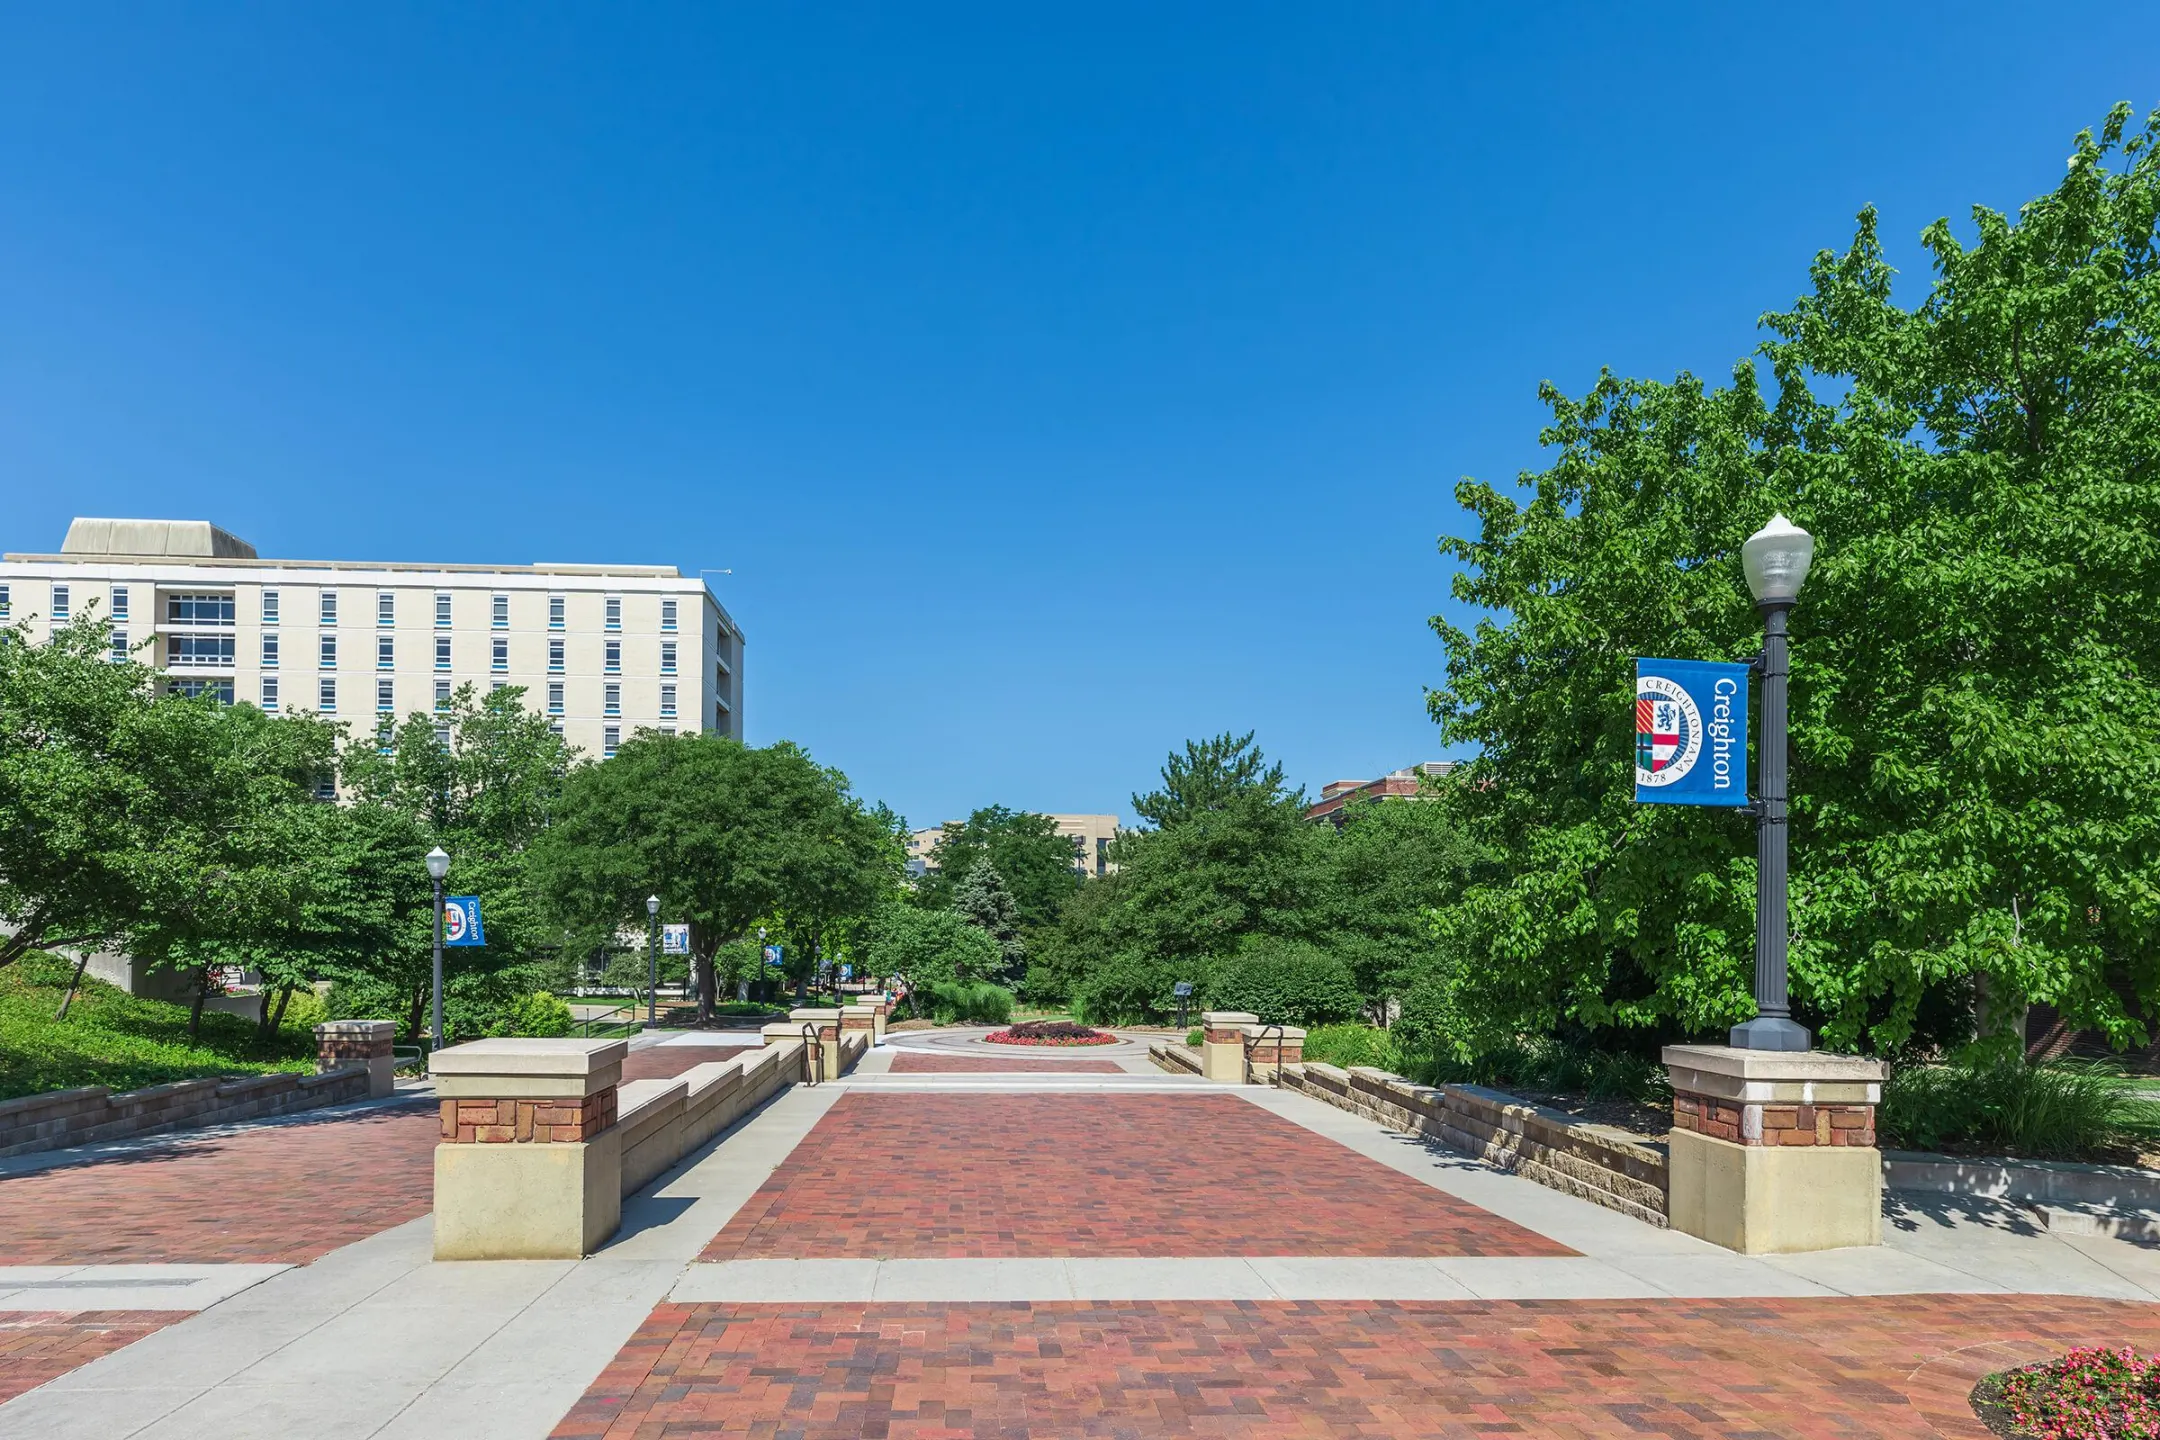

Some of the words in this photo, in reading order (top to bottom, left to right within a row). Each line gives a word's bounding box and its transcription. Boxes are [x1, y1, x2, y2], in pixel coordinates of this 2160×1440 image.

[1645, 679, 1700, 773] CREIGHTONIANA
[1708, 677, 1737, 790] Creighton
[1640, 773, 1667, 784] 1878
[467, 901, 479, 941] Creighton
